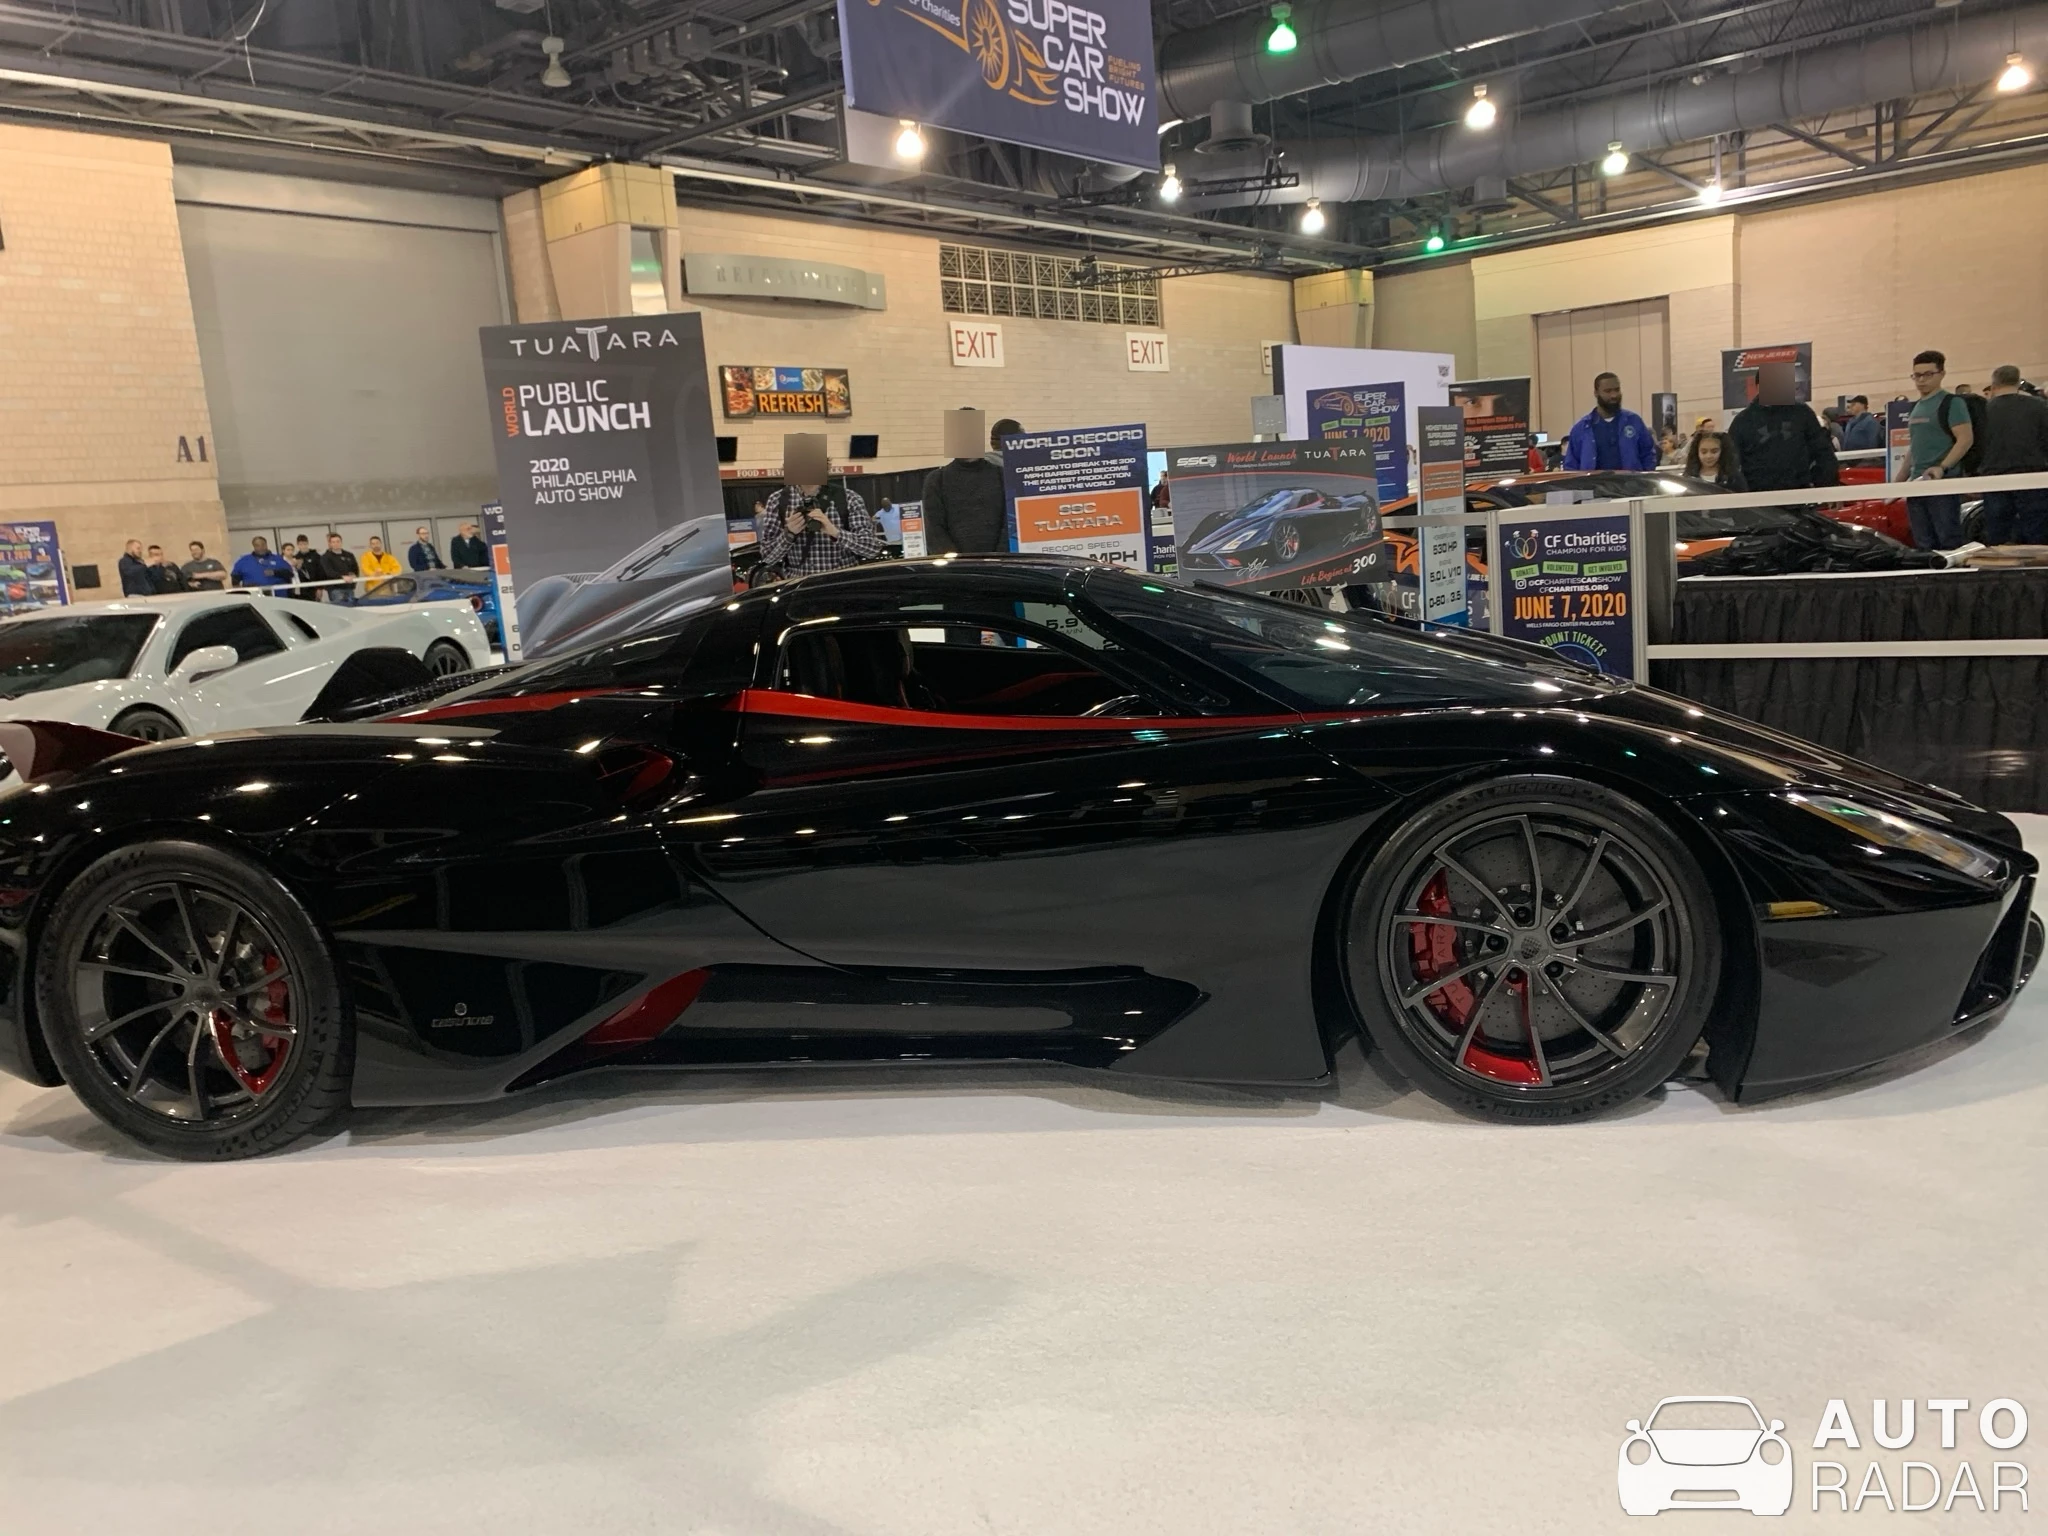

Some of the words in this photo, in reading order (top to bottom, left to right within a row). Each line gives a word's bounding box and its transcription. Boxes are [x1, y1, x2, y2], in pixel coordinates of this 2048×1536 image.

[1008, 0, 1107, 49] SUPER
[1043, 35, 1105, 83] CAR
[1108, 55, 1142, 72] FUELING
[1108, 65, 1138, 78] BRIGHT
[1108, 74, 1146, 91] FUTURES
[1064, 79, 1146, 127] SHOW
[510, 325, 679, 363] TUATARA
[955, 330, 998, 359] EXIT
[1130, 340, 1164, 365] EXIT
[519, 380, 609, 407] PUBLIC
[1353, 392, 1387, 401] SUPER
[758, 393, 824, 413] REFRESH
[1370, 405, 1400, 414] SHOW
[503, 387, 520, 437] WORLD
[522, 402, 651, 436] LAUNCH
[1005, 435, 1070, 450] WORLD
[1073, 429, 1143, 444] RECORD
[176, 435, 209, 463] A1
[1050, 446, 1101, 460] SOON
[1227, 451, 1257, 463] World
[1261, 449, 1297, 462] Launch
[1305, 447, 1366, 461] TUATARA
[530, 458, 569, 473] 2020
[1035, 464, 1058, 472] SOON
[1072, 461, 1100, 469] BREAK
[1177, 456, 1209, 467] SSC
[532, 469, 637, 489] PHILADELPHIA
[737, 469, 759, 477] FOOD
[1040, 476, 1076, 485] FASTEST
[1077, 472, 1131, 482] PRODUCTION
[1045, 470, 1080, 478] BARRIER
[1093, 465, 1129, 473] BECOME
[1084, 480, 1115, 488] WORLD
[535, 489, 576, 504] AUTO
[578, 486, 624, 502] SHOW
[1059, 502, 1097, 516] SSC
[1034, 515, 1123, 532] TUATARA
[1544, 535, 1561, 548] CF
[1564, 531, 1627, 546] Charities
[1042, 544, 1083, 553] RECORD
[1089, 550, 1137, 563] MPH
[1153, 544, 1176, 554] harit
[1546, 547, 1589, 555] CHAMPION
[1301, 573, 1317, 586] Life
[1317, 567, 1343, 582] Begins
[1352, 553, 1376, 574] 300
[1528, 576, 1621, 587] @CFCHARITIESCARSHOW
[1539, 584, 1609, 593] CFCHARITIES.ORG
[1402, 592, 1416, 609] CF
[1514, 595, 1555, 621] JUNE
[1561, 595, 1576, 622] 7,
[1580, 592, 1627, 618] 2020
[1540, 631, 1569, 647] COUNT
[1572, 630, 1607, 657] TICKETS
